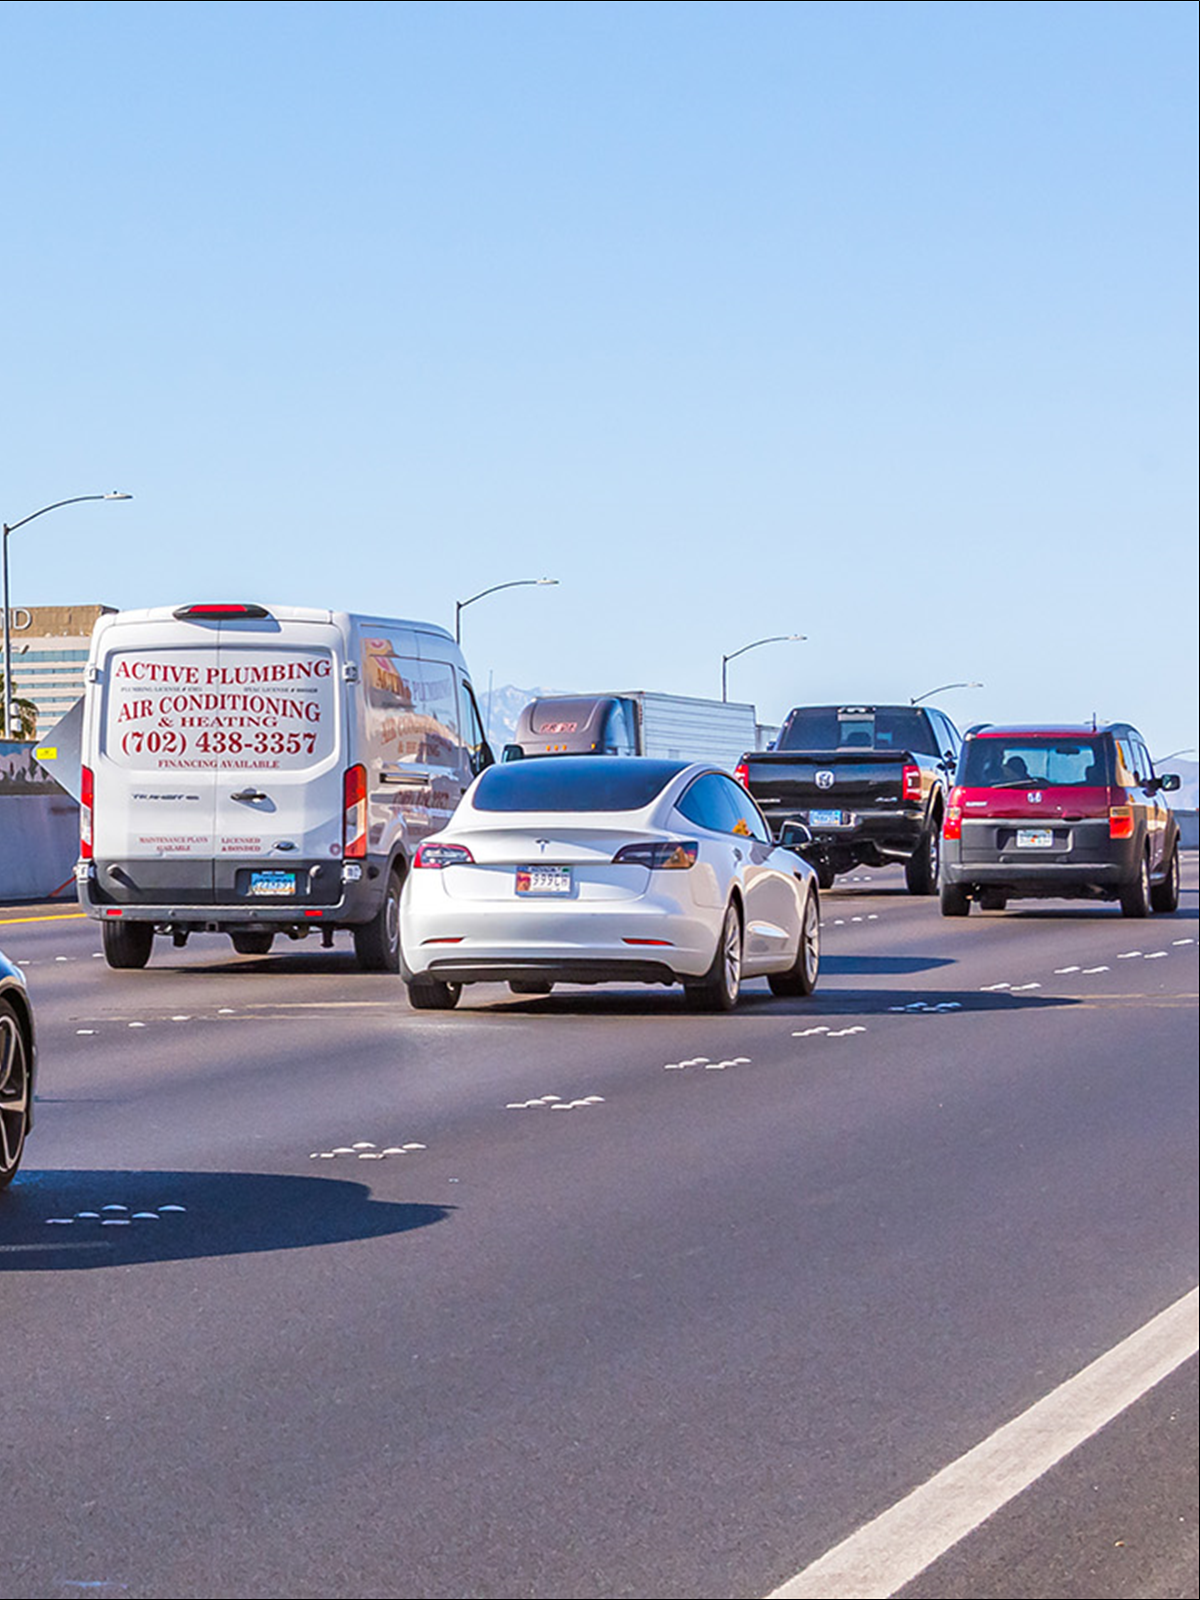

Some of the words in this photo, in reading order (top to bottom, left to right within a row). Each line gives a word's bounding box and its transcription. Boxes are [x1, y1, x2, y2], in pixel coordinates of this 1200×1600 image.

[115, 661, 199, 684] ACTIVE
[206, 659, 331, 684] PLUMBING
[117, 699, 154, 723] AIR
[159, 693, 321, 723] CONDITIONING
[157, 717, 174, 728] &
[180, 716, 278, 728] HEATING
[121, 730, 188, 756] (702)
[194, 731, 317, 755] 438-3357
[157, 760, 218, 768] FINANCING
[220, 760, 280, 768] AVAILABLE
